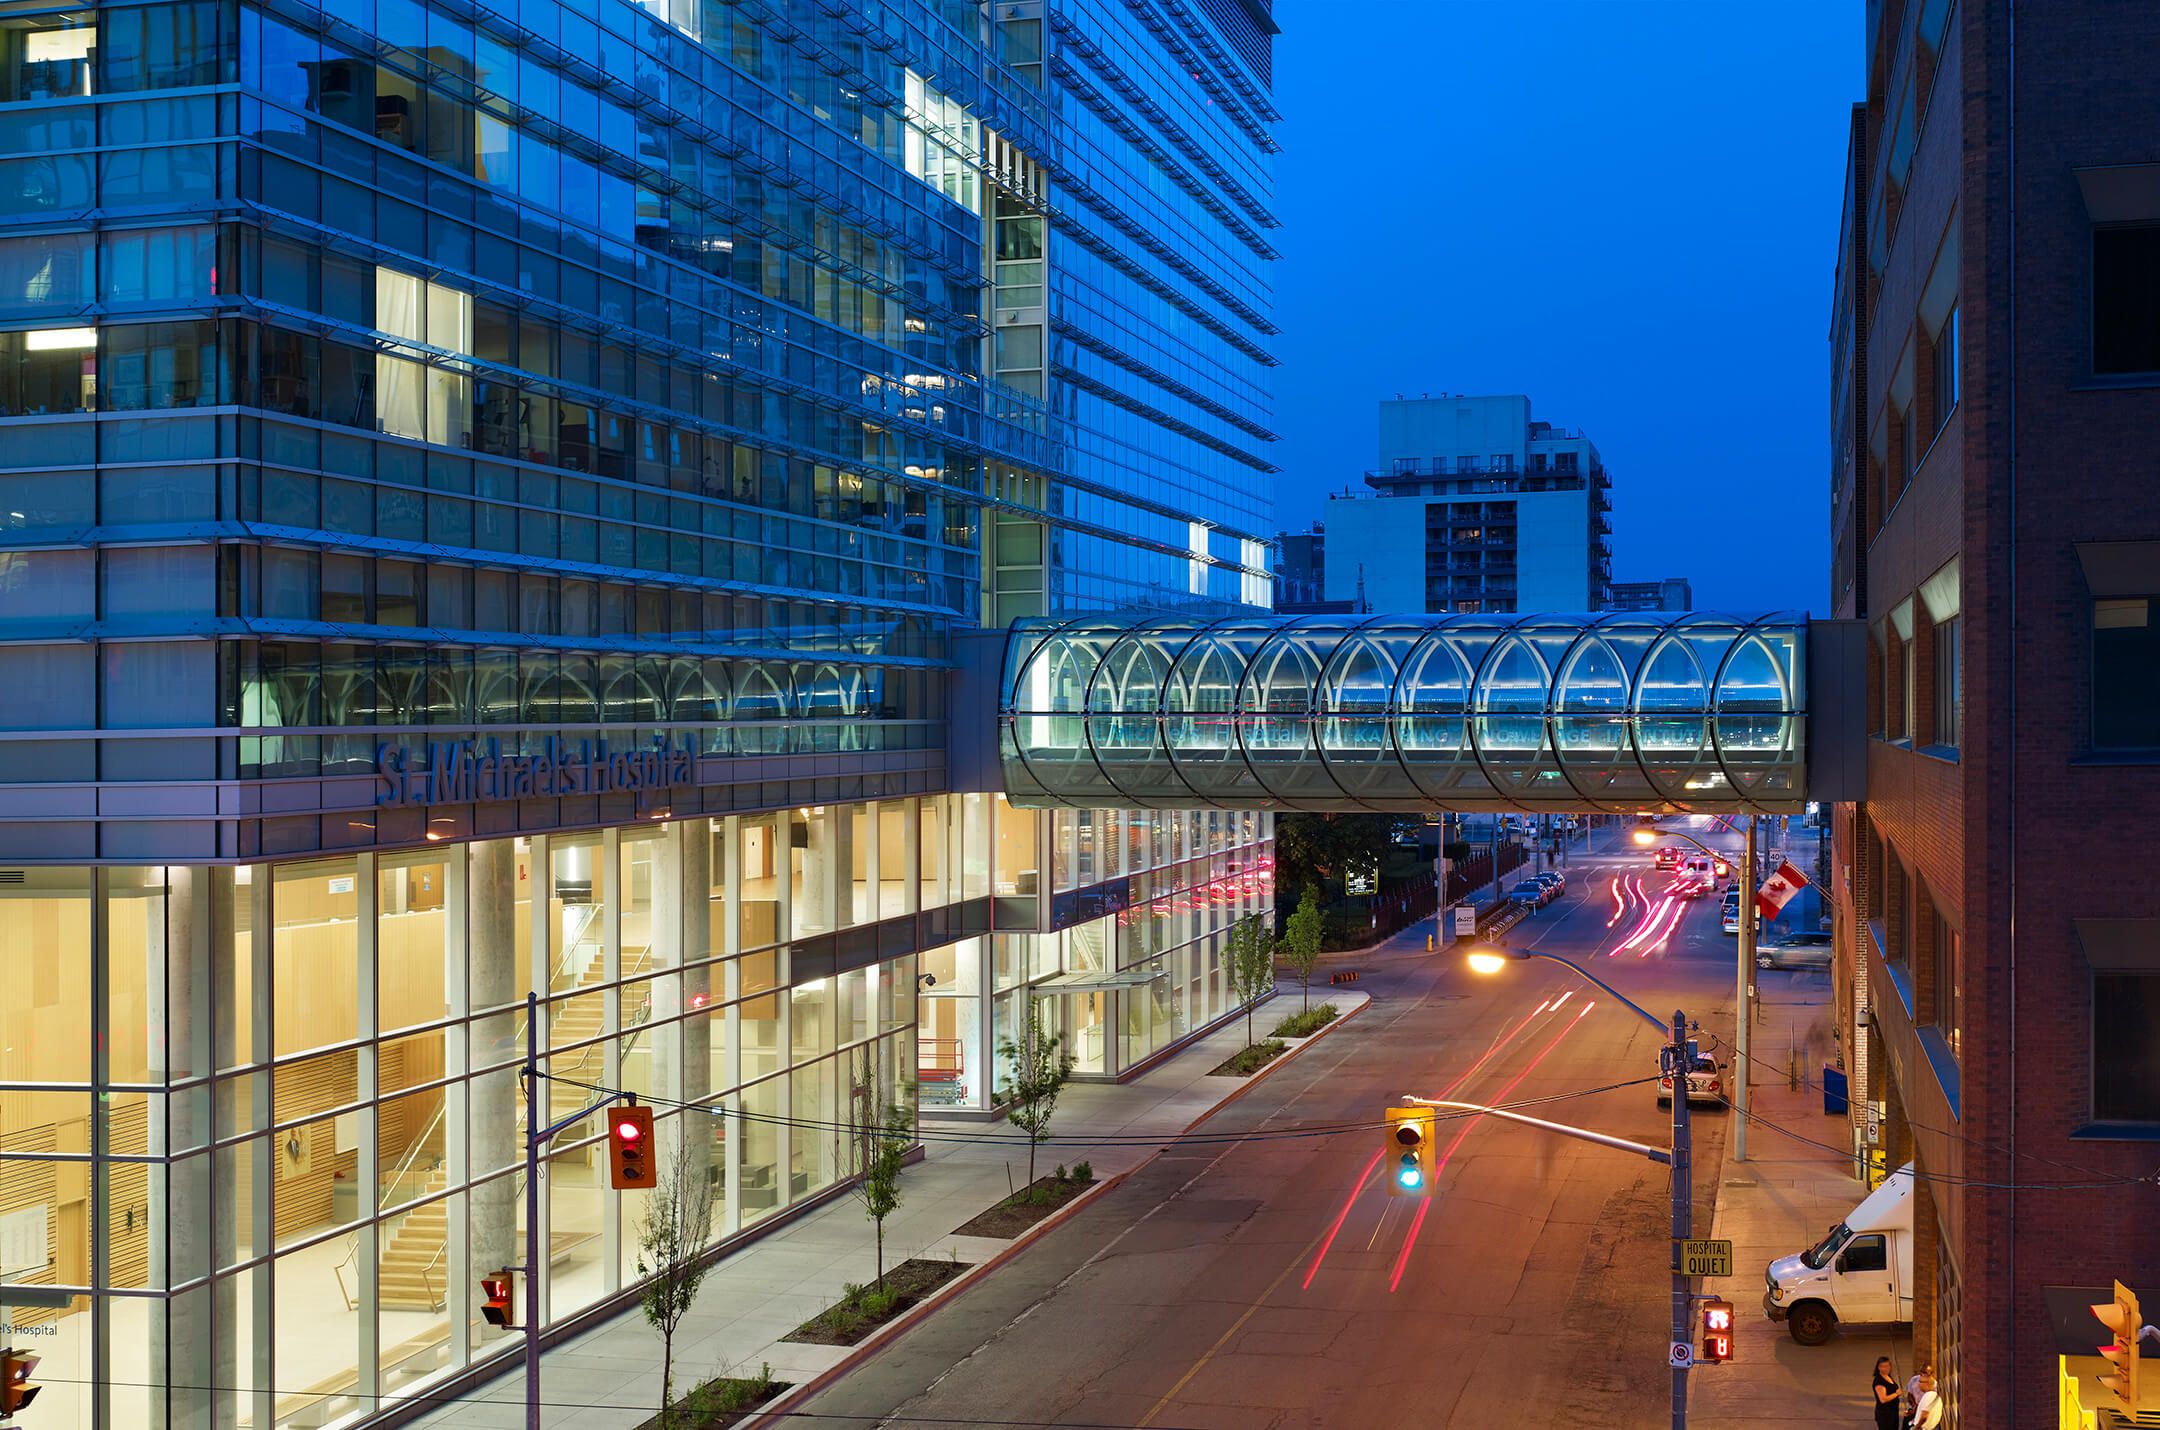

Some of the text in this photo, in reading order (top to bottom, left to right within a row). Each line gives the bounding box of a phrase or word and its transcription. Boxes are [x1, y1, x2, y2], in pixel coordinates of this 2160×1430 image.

[378, 732, 697, 809] St. Michael's Hospital
[1687, 1243, 1726, 1255] HOSPITAL
[1689, 1258, 1726, 1273] QUIET
[14, 1324, 58, 1338] Hospital
